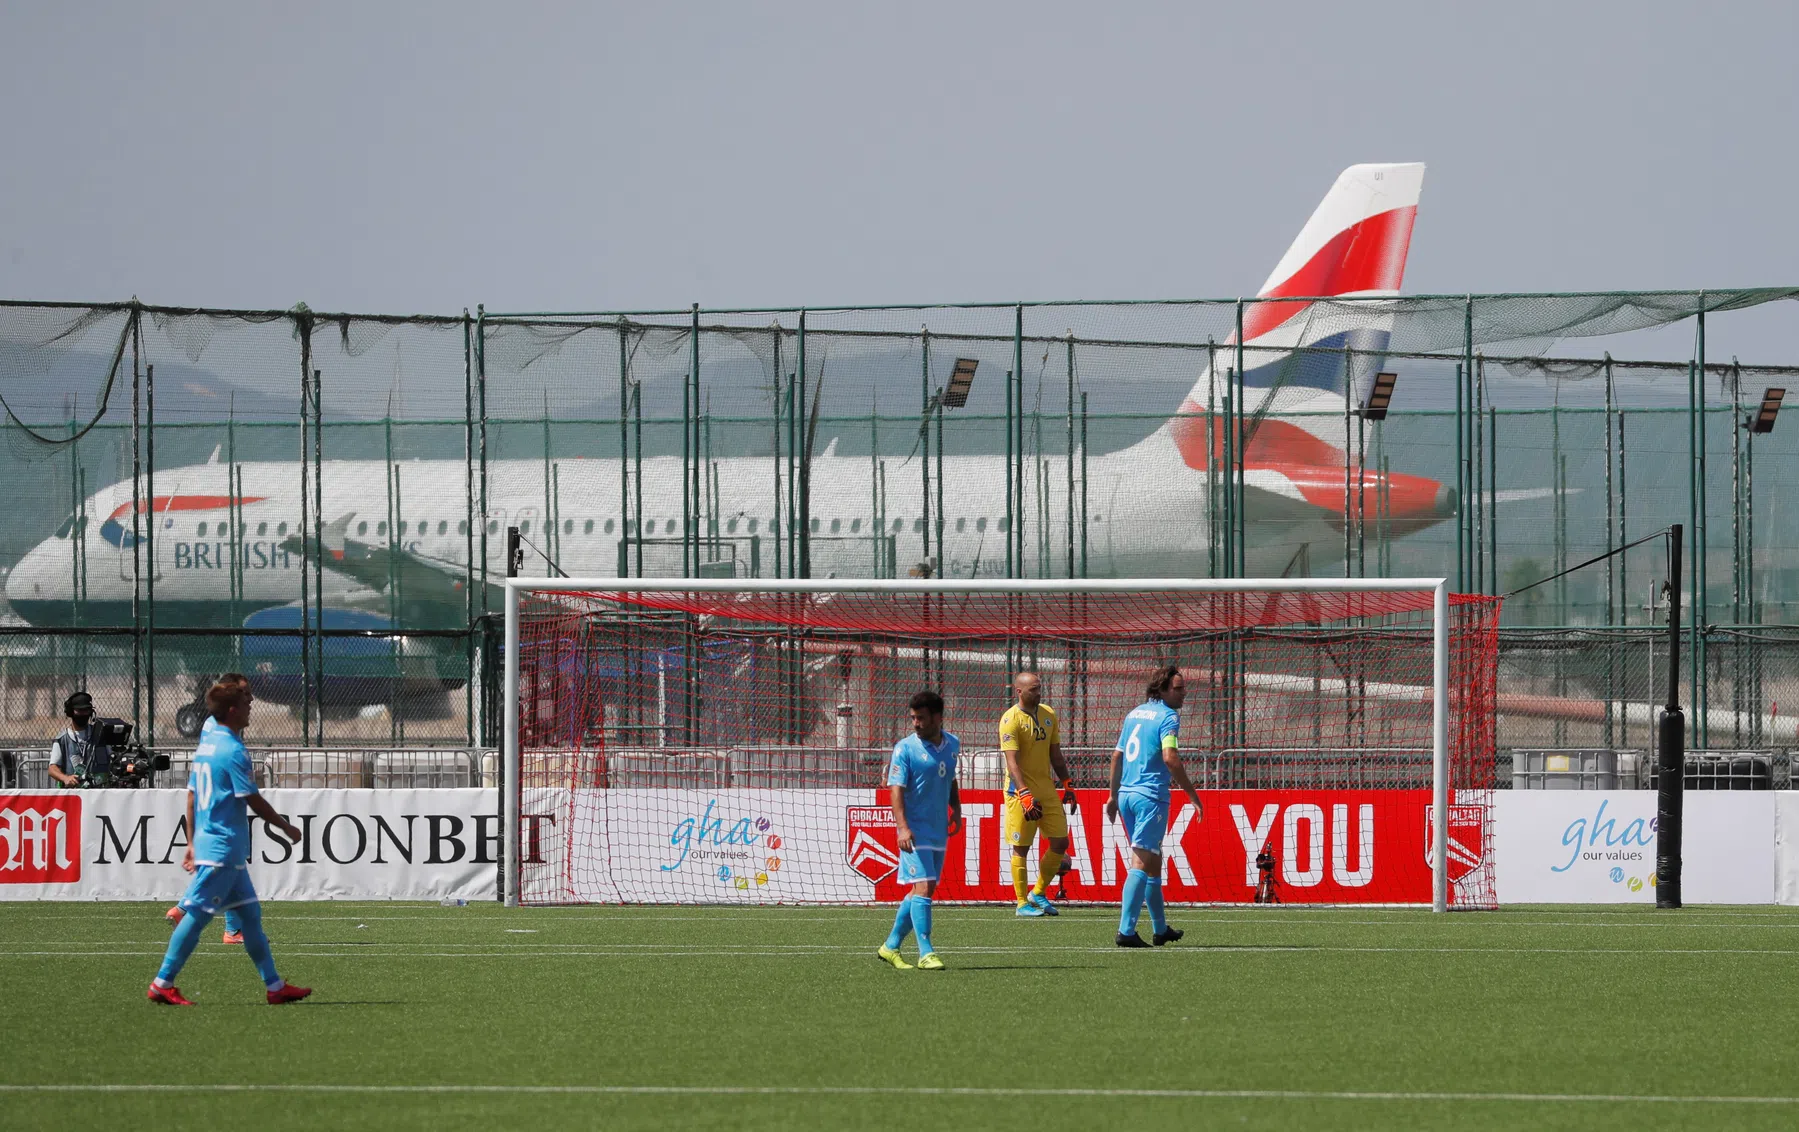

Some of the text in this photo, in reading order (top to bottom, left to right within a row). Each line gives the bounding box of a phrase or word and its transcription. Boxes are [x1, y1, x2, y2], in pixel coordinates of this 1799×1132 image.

[1033, 727, 1047, 742] 23
[1125, 724, 1142, 763] 6
[938, 760, 947, 779] 8
[850, 810, 897, 821] GIBRALTA
[92, 812, 557, 865] MASIONBET
[660, 799, 759, 871] gha
[1228, 803, 1374, 887] YOU
[1551, 799, 1653, 872] gha
[691, 849, 749, 860] our values
[1583, 849, 1643, 861] our values
